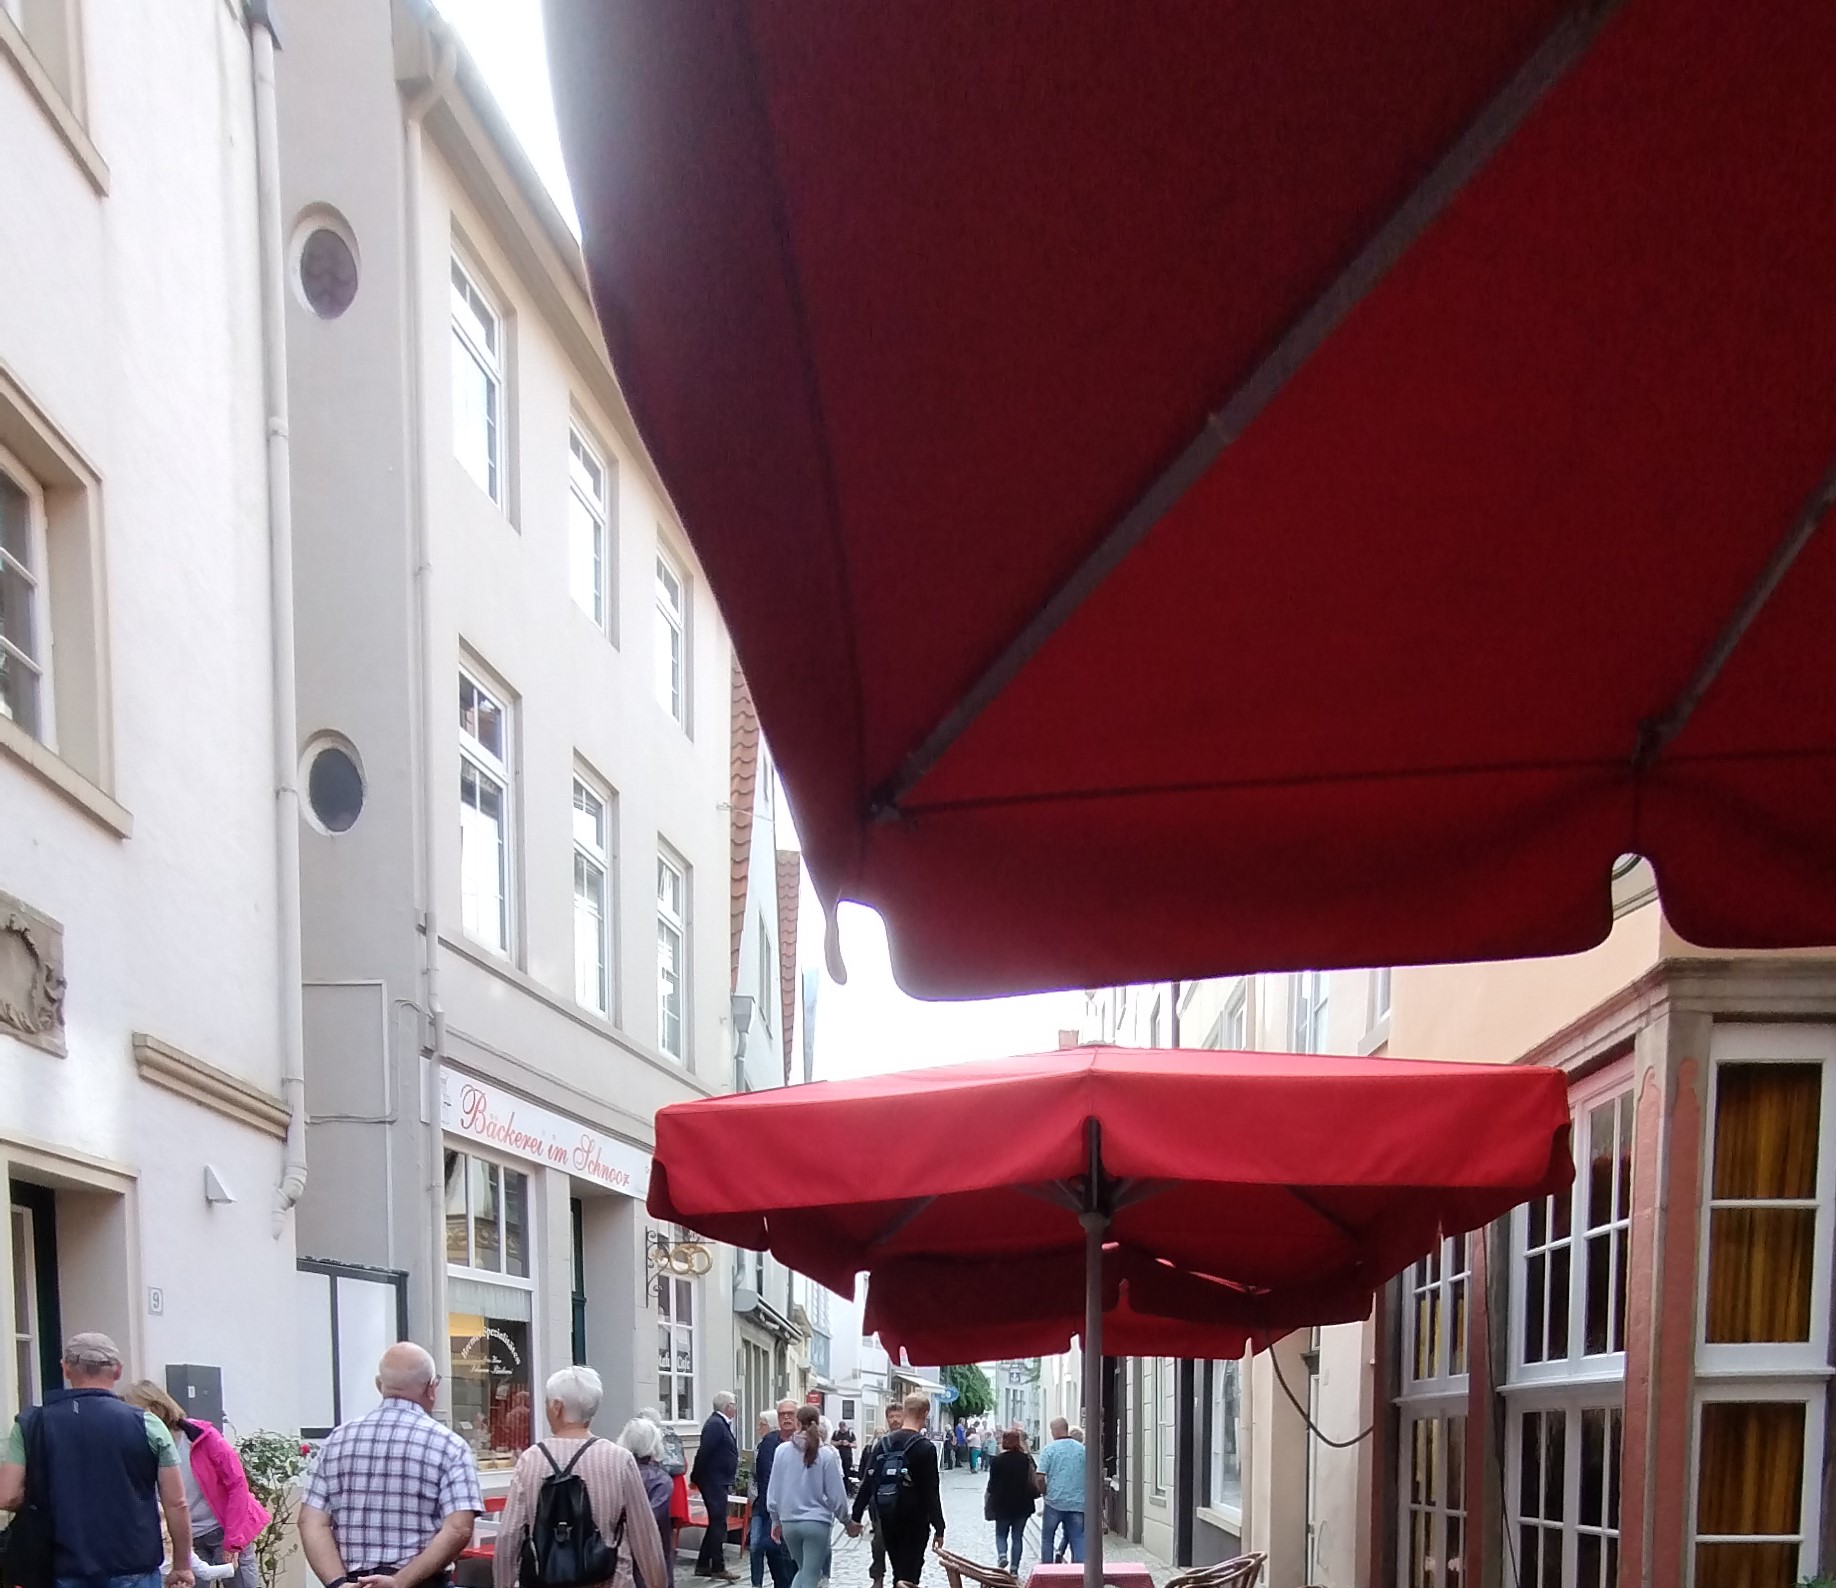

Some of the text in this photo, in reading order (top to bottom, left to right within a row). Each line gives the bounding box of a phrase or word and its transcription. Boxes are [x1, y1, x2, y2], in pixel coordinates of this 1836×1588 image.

[460, 1084, 630, 1187] Bäckerei im Schnoor
[152, 1291, 160, 1309] 9
